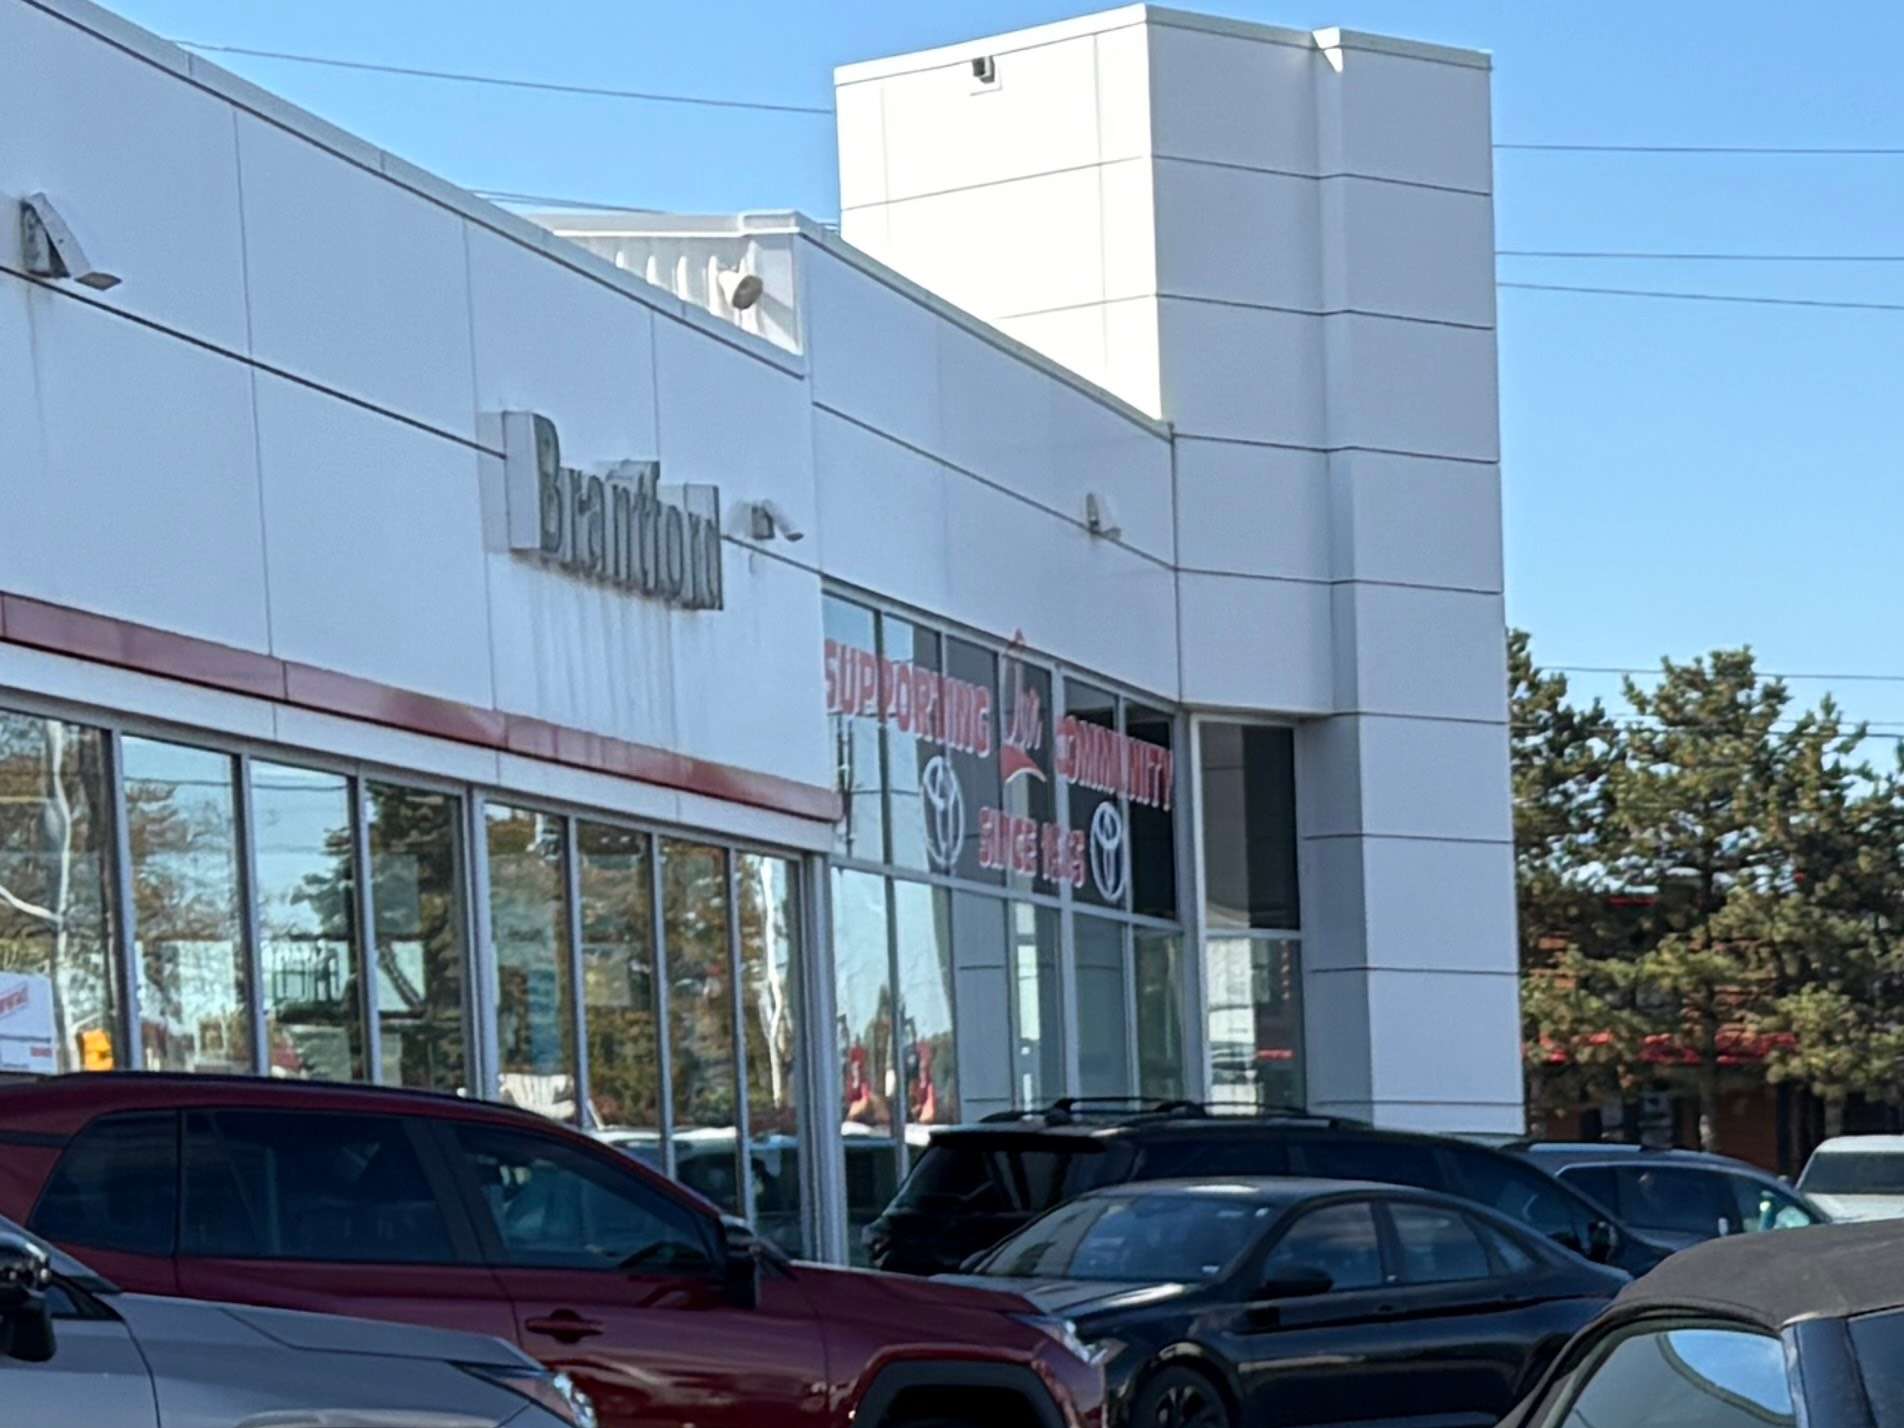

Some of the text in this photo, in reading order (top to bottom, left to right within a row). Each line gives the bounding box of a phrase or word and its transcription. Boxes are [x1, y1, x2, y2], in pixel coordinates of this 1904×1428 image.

[512, 410, 723, 611] Brantford
[824, 638, 991, 758] SUPPORTING
[1056, 714, 1173, 812] COMMUNITY
[978, 806, 1038, 878] SINCE
